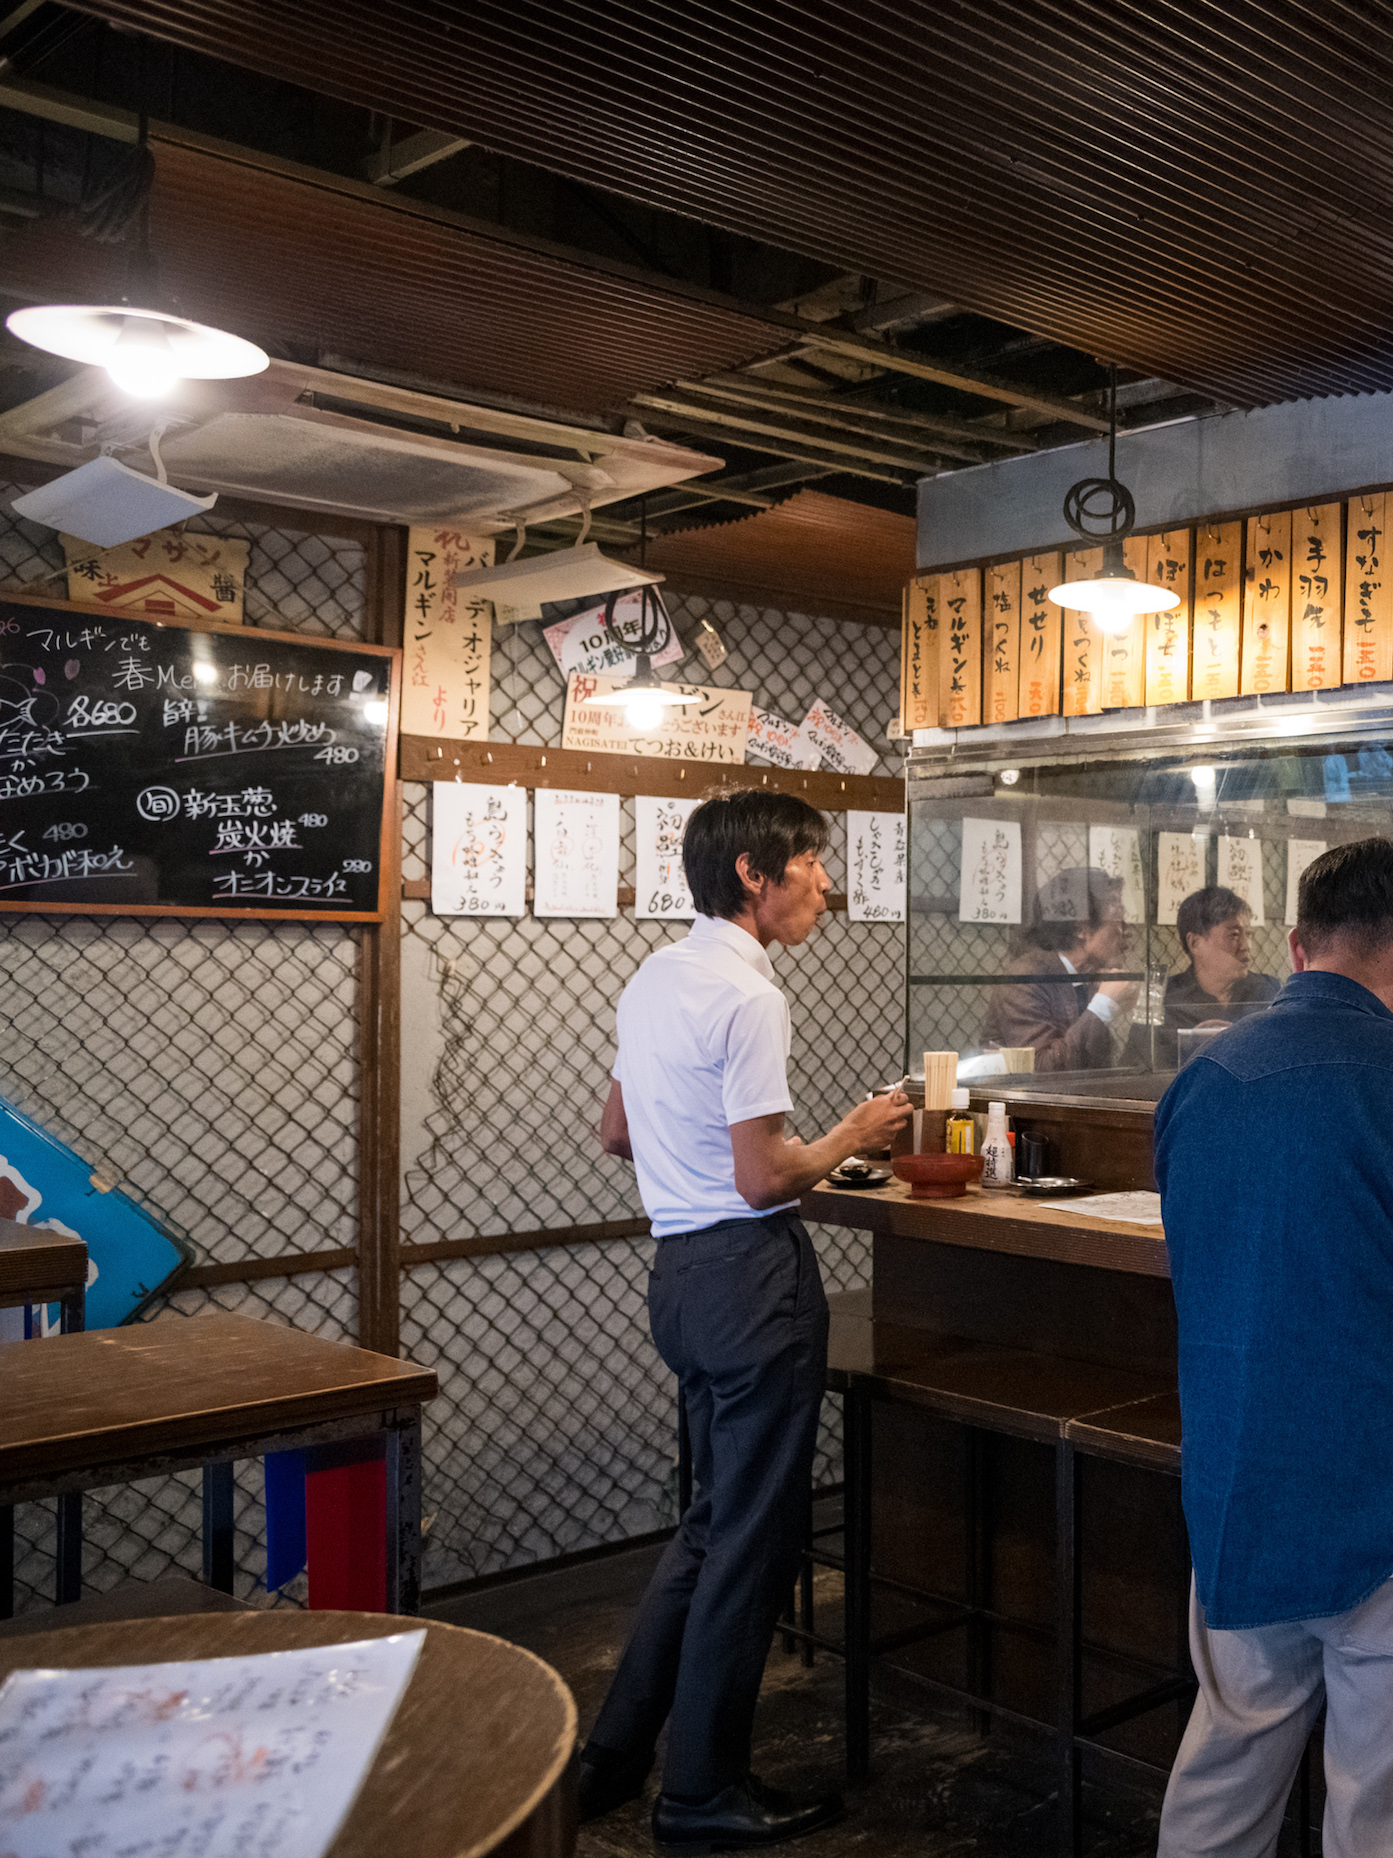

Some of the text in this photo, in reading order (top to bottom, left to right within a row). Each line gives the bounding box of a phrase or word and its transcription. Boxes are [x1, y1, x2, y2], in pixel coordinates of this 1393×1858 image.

[1258, 547, 1283, 601] かわ
[1299, 536, 1328, 629] 手羽先
[413, 550, 437, 641] マルギン
[1155, 559, 1186, 656] ぼぼち
[993, 590, 1012, 673] 塩つくね
[1027, 584, 1048, 663] せせり
[460, 552, 489, 737] バデ・オジャリア
[572, 674, 598, 705] 祝
[313, 746, 360, 765] 480
[183, 786, 278, 820] 新玉葱
[43, 821, 89, 842] 480
[215, 813, 328, 849] 炭火焼 480
[0, 844, 134, 882] ボカド和え
[213, 870, 347, 898] オニオンスライス
[648, 890, 694, 914] 680
